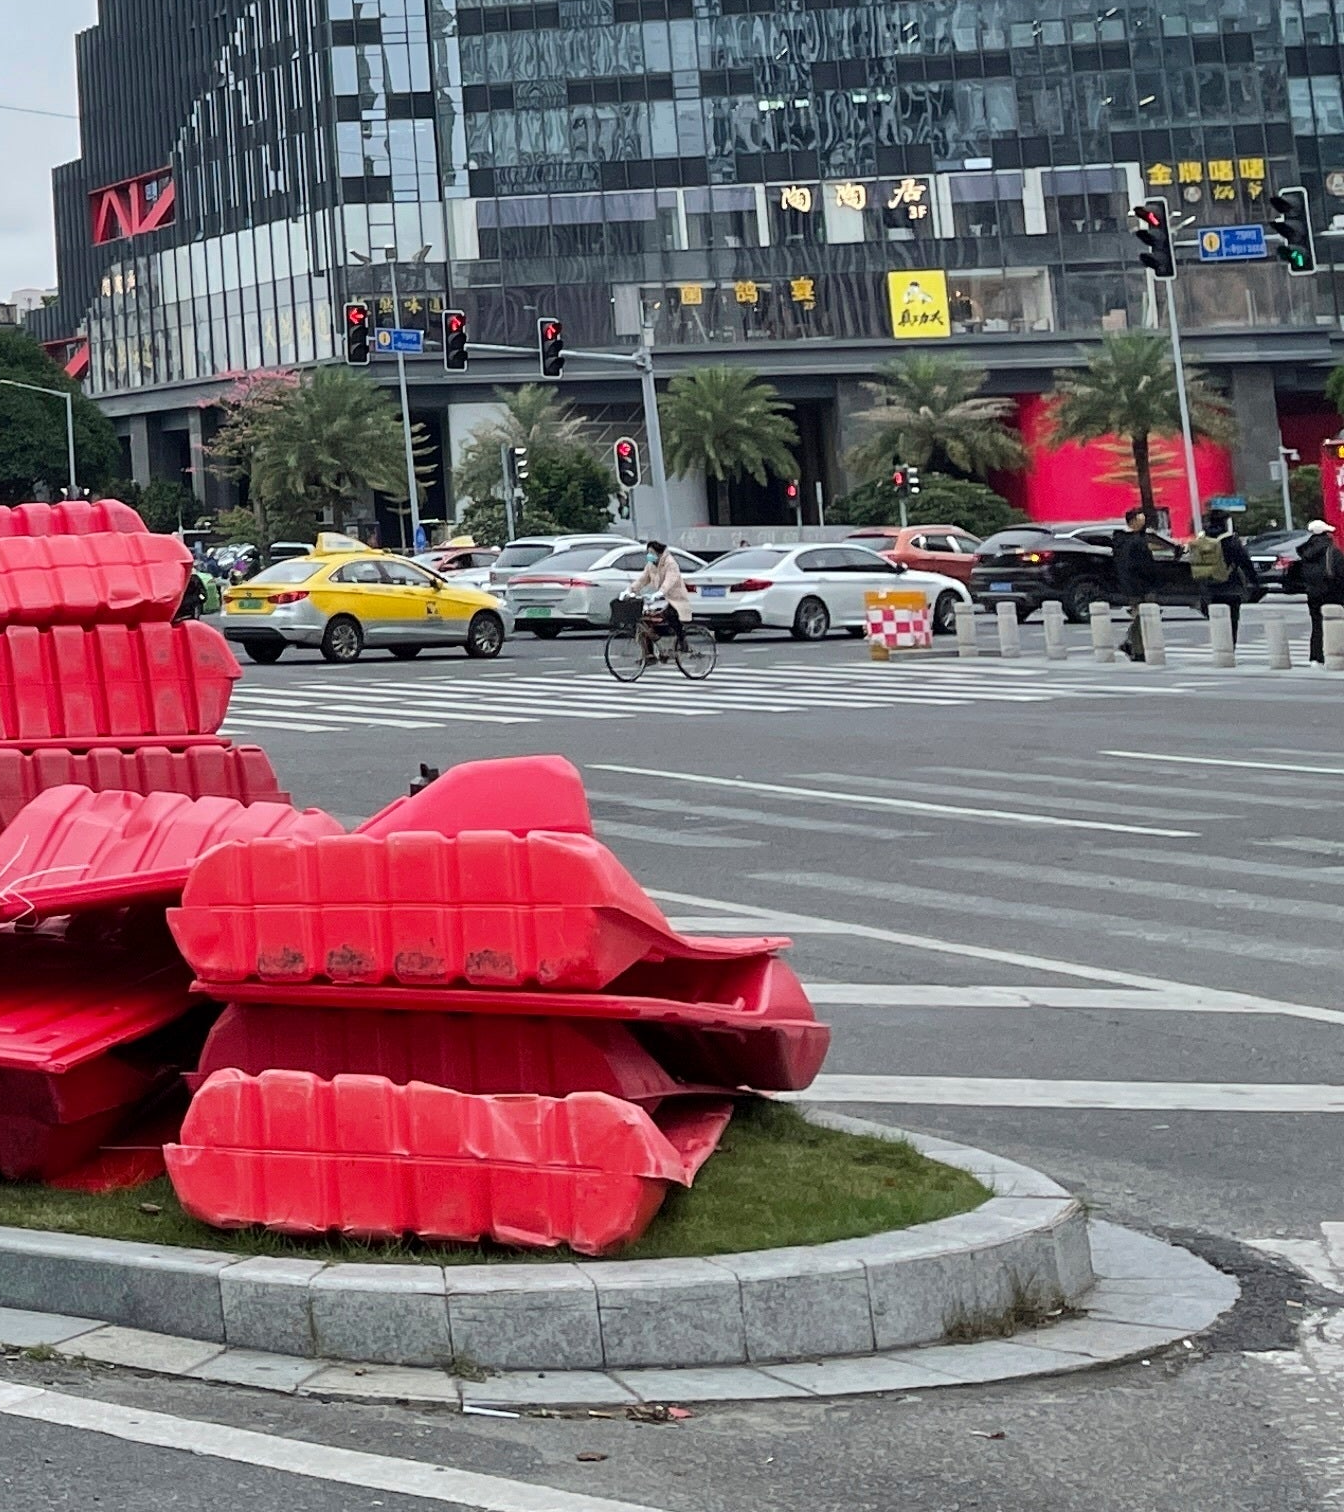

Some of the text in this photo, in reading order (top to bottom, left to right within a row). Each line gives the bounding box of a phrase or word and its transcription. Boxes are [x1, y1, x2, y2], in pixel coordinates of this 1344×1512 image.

[780, 178, 927, 213] 陶陶居
[908, 205, 928, 220] 3F
[897, 308, 945, 329] 真功夫
